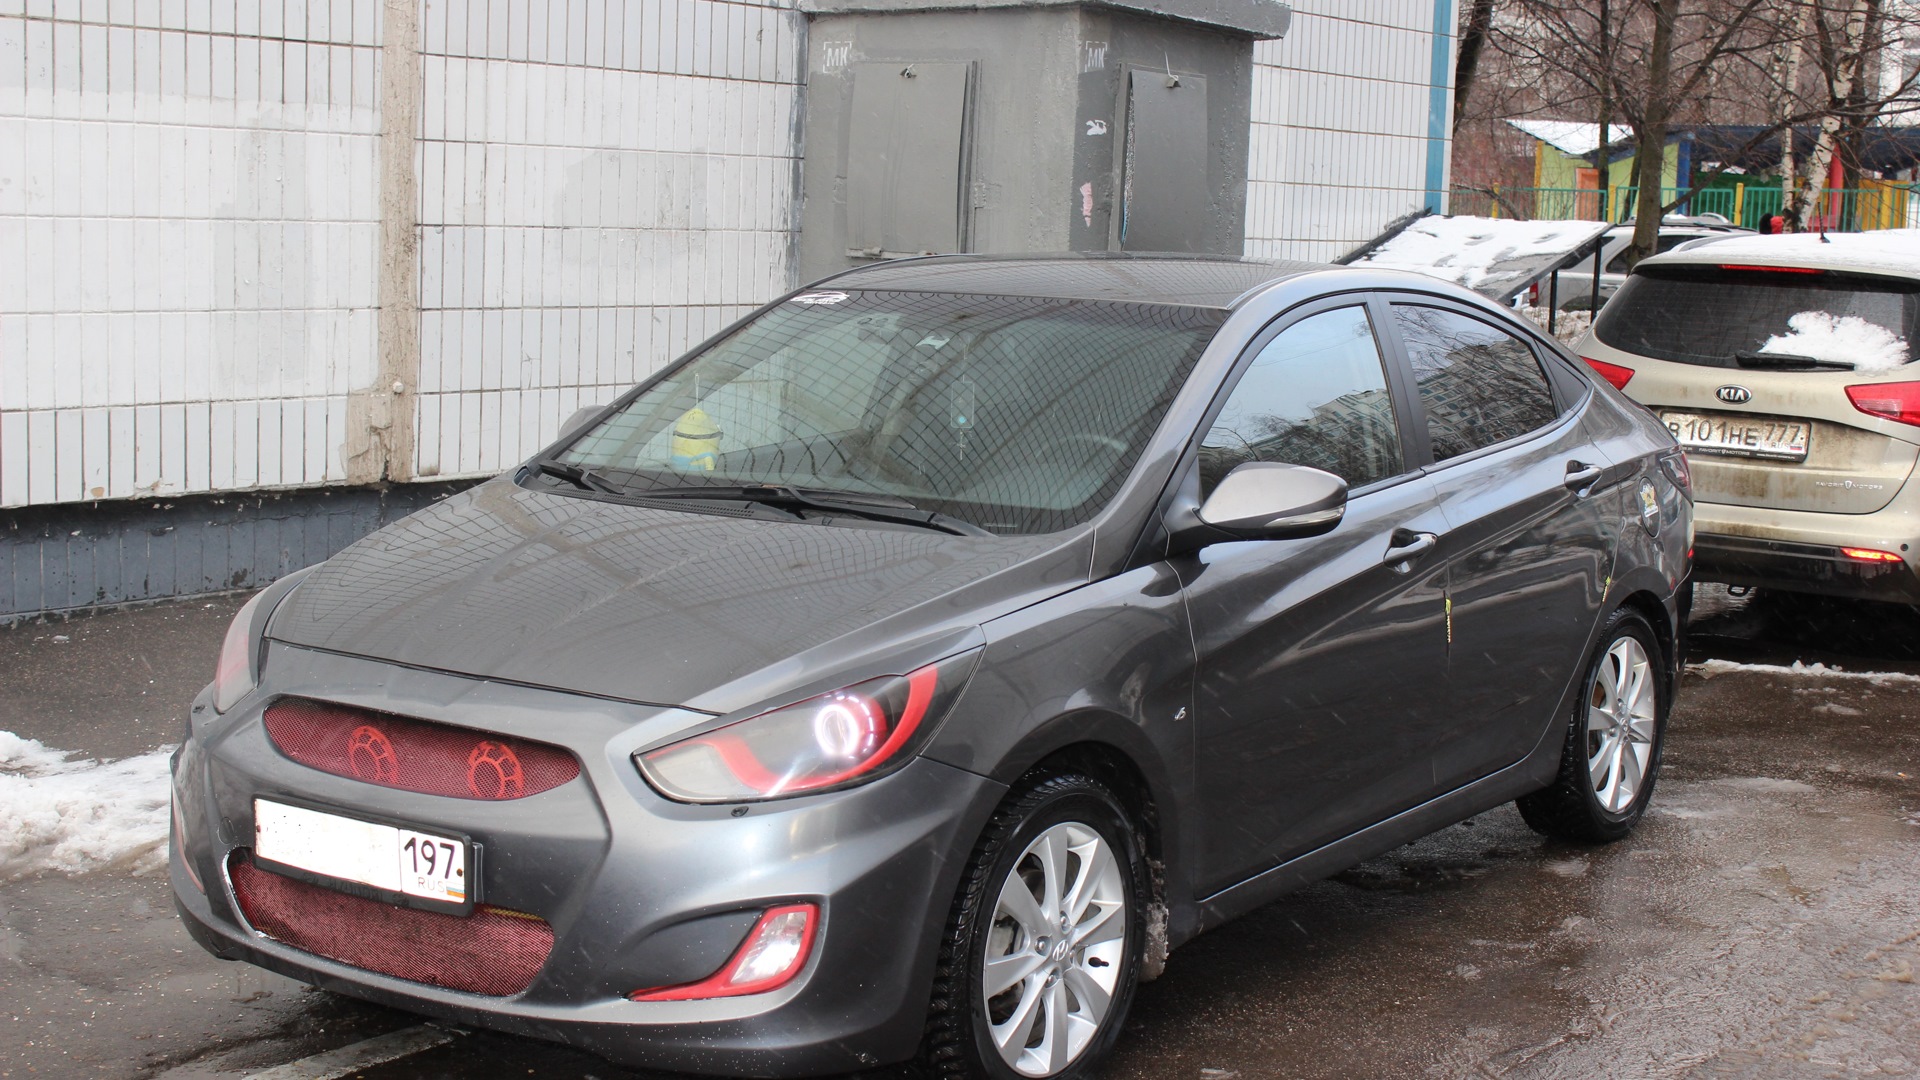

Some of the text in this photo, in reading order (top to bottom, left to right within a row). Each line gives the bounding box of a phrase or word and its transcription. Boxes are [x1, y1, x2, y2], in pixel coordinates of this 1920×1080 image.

[1719, 388, 1746, 401] KIA
[403, 837, 455, 880] 197
[418, 876, 445, 893] RUS
